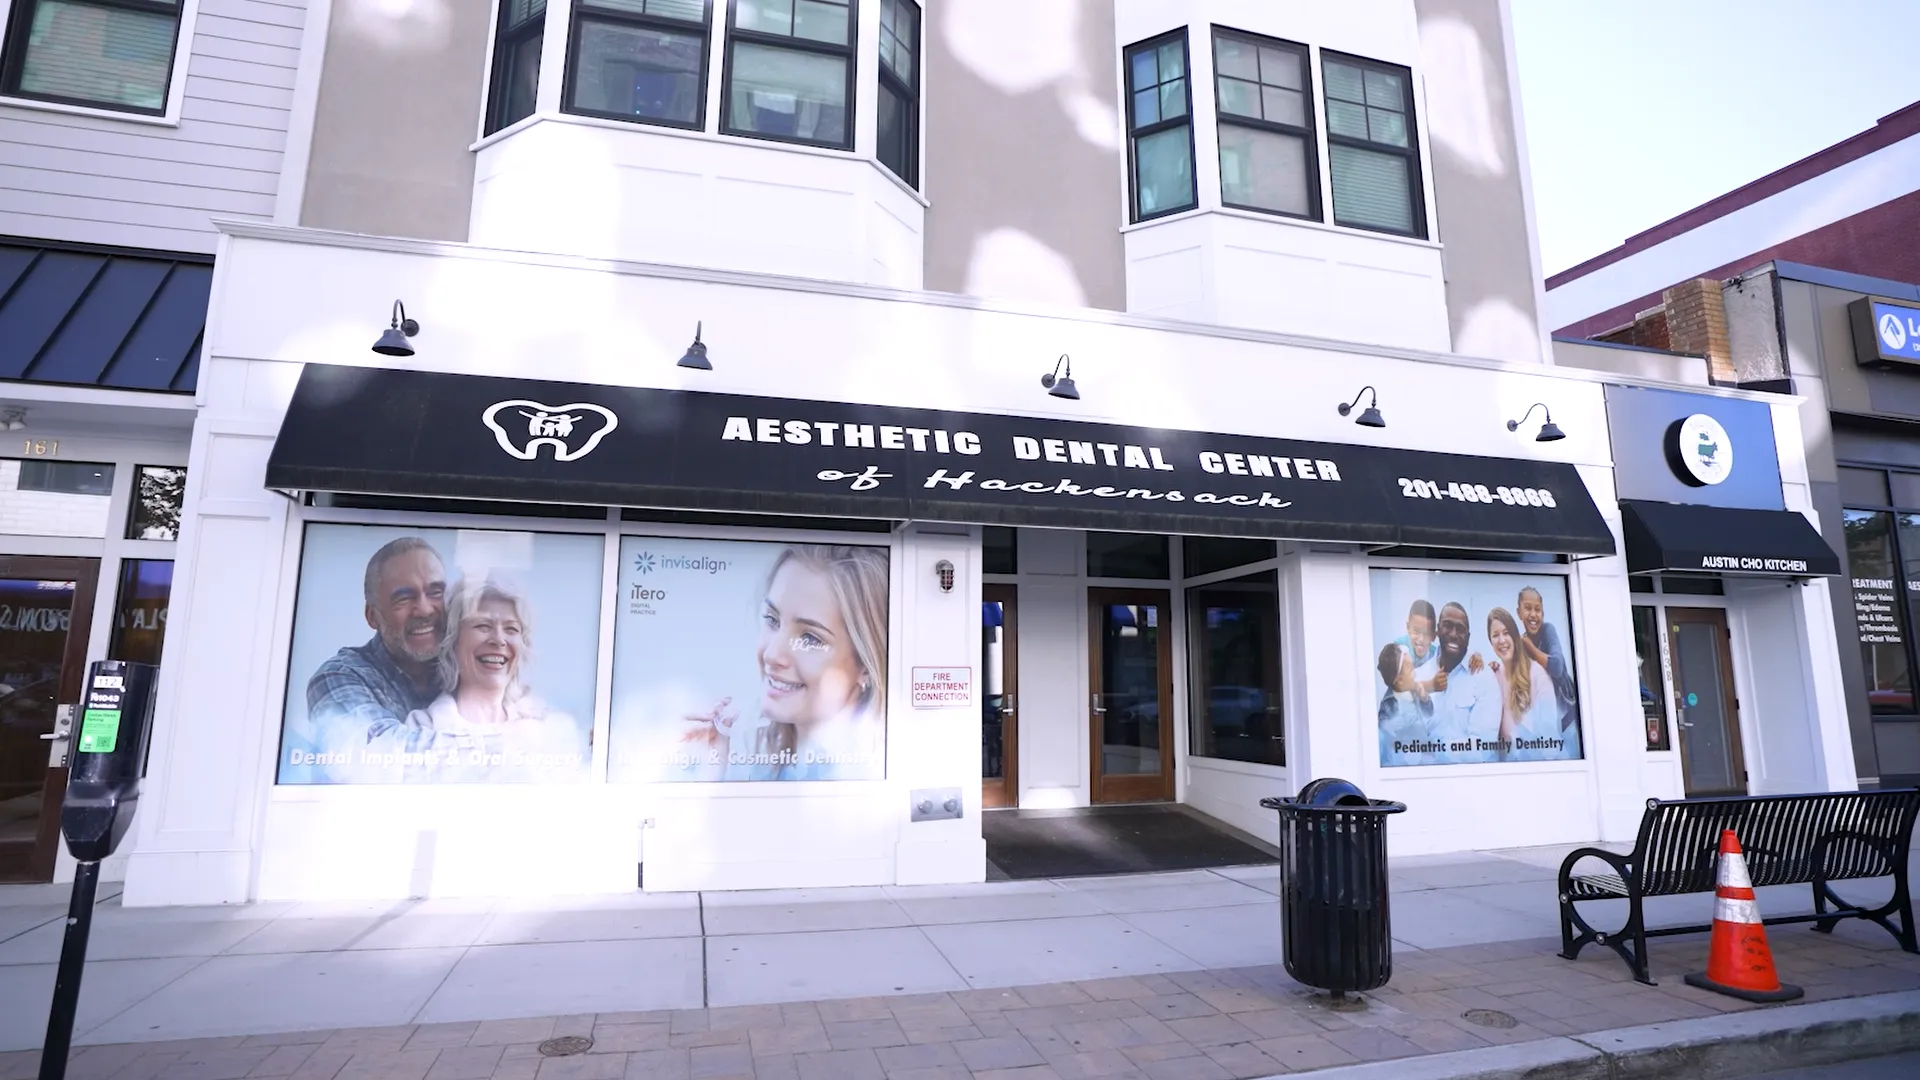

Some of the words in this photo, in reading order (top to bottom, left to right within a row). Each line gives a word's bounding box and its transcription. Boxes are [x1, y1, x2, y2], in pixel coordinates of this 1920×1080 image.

[24, 440, 59, 456] 161
[721, 416, 982, 455] AESTHETIC
[1012, 436, 1174, 471] DENTAL
[1198, 451, 1342, 481] CENTER
[816, 466, 894, 491] of
[923, 468, 1292, 508] Hackensack
[660, 554, 727, 574] invisalign
[1702, 556, 1740, 568] AUSTIN
[1740, 557, 1763, 569] CHO
[1764, 558, 1807, 571] KITCHEN
[630, 582, 666, 600] iTero
[932, 673, 951, 681] FIRE
[914, 682, 969, 691] DEPARTMENT
[914, 692, 969, 701] CONNECTION
[1394, 739, 1446, 753] Pediatric
[1450, 738, 1472, 752] and
[1476, 737, 1512, 753] Family
[1516, 736, 1564, 751] Dentistry
[289, 748, 352, 767] Dental
[361, 749, 440, 770] Implants
[446, 750, 461, 767] &
[469, 750, 506, 767] Oral
[708, 748, 723, 765] &
[728, 748, 799, 766] Cosmetic
